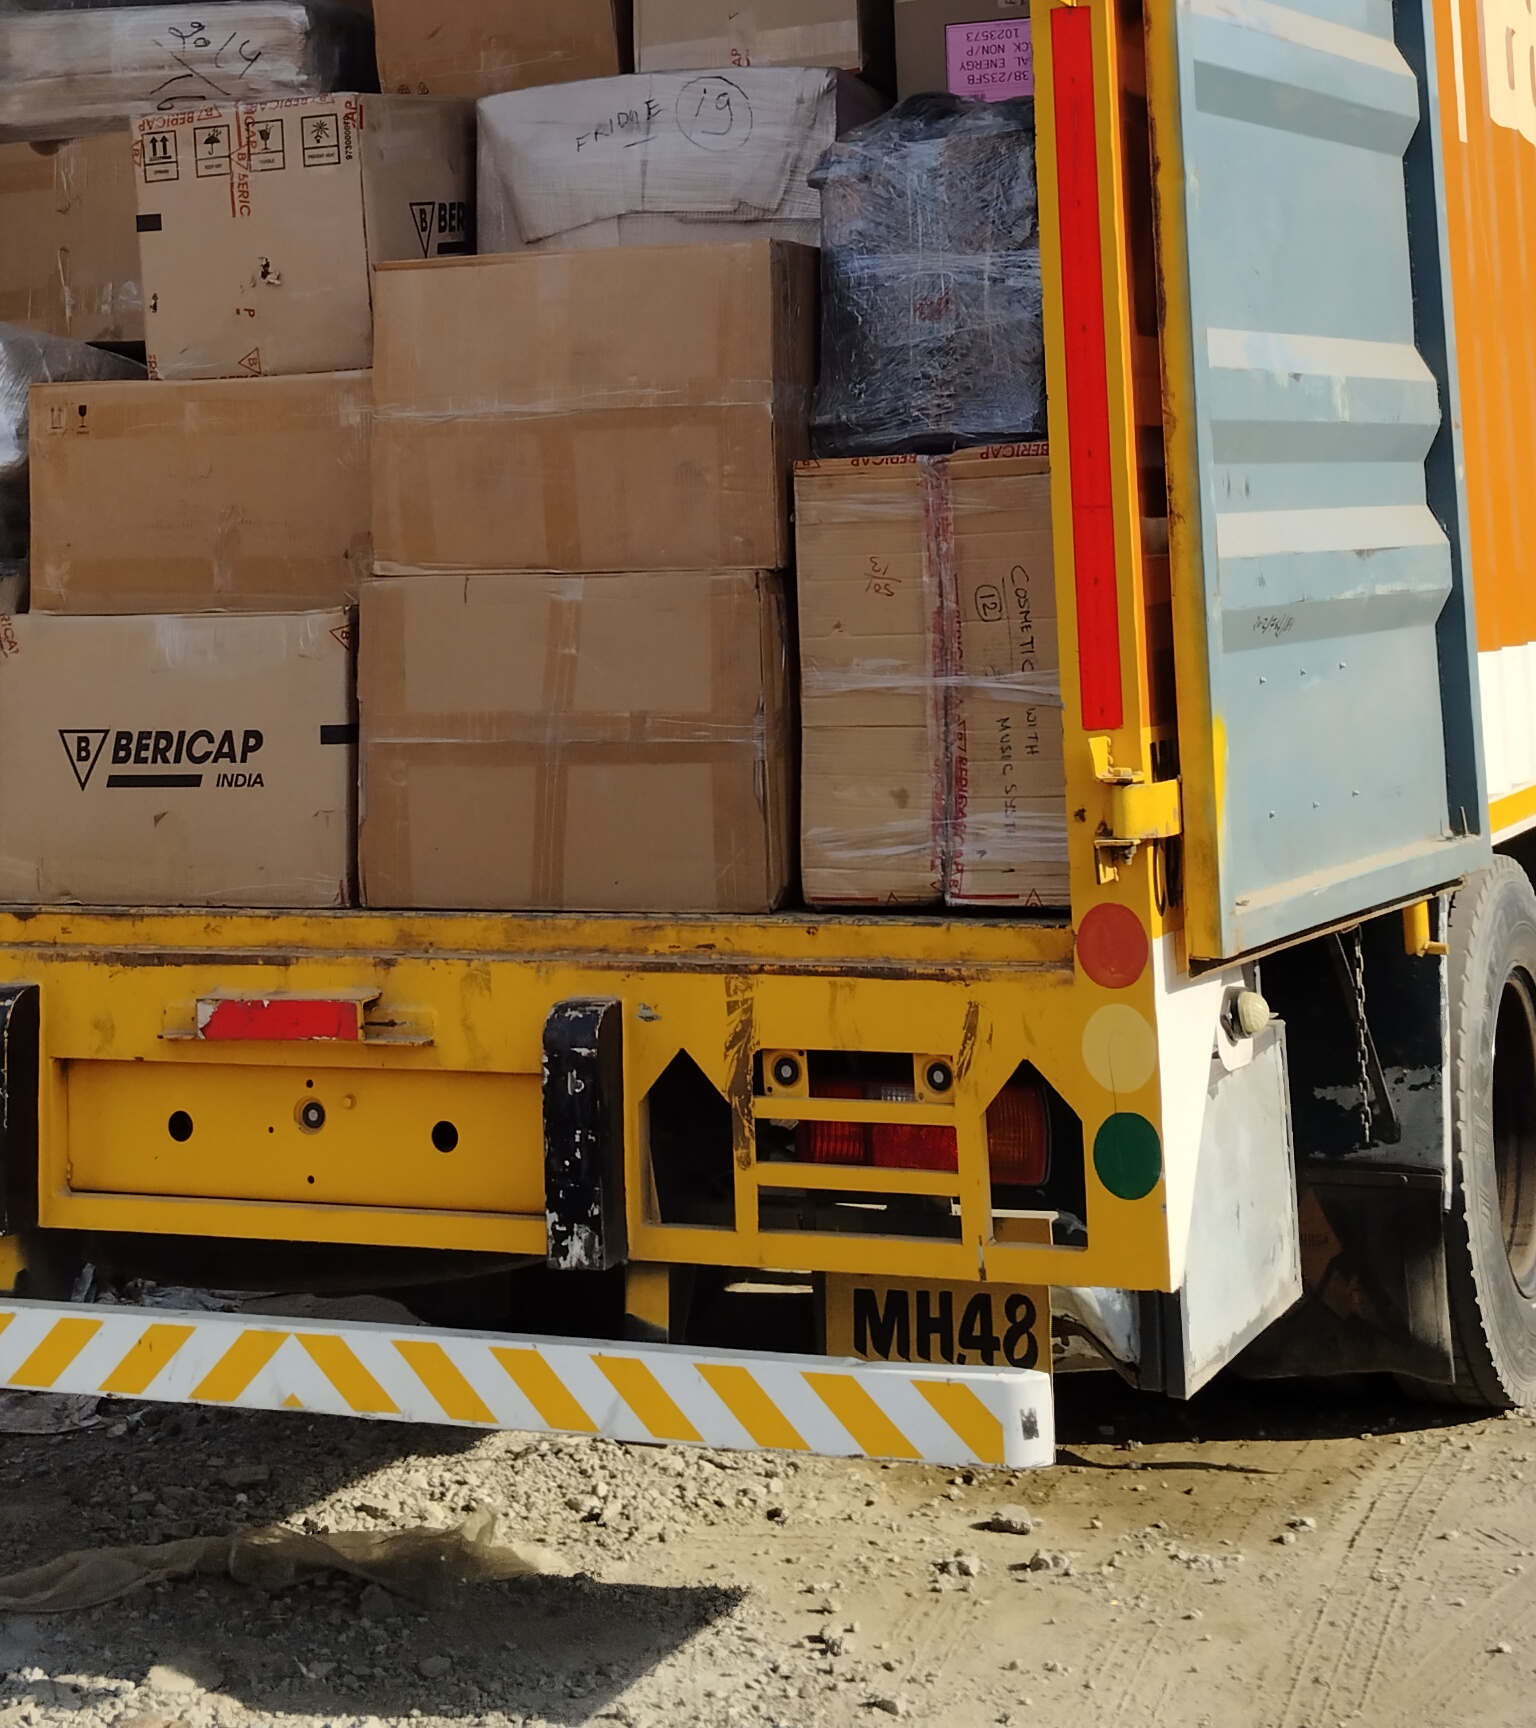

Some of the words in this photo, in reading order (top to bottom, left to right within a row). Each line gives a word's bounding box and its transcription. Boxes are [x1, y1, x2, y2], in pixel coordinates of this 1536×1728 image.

[966, 28, 1019, 42] 1023573
[966, 43, 1005, 56] NON/P
[960, 58, 1005, 71] ENERGY
[980, 443, 1049, 460] BERICAP
[979, 593, 998, 617] 12
[1011, 565, 1035, 673] COSMETIC
[1025, 707, 1039, 756] WITH
[111, 729, 264, 765] BERICAP
[996, 717, 1014, 775] MUSIC
[215, 773, 264, 788] INDIA
